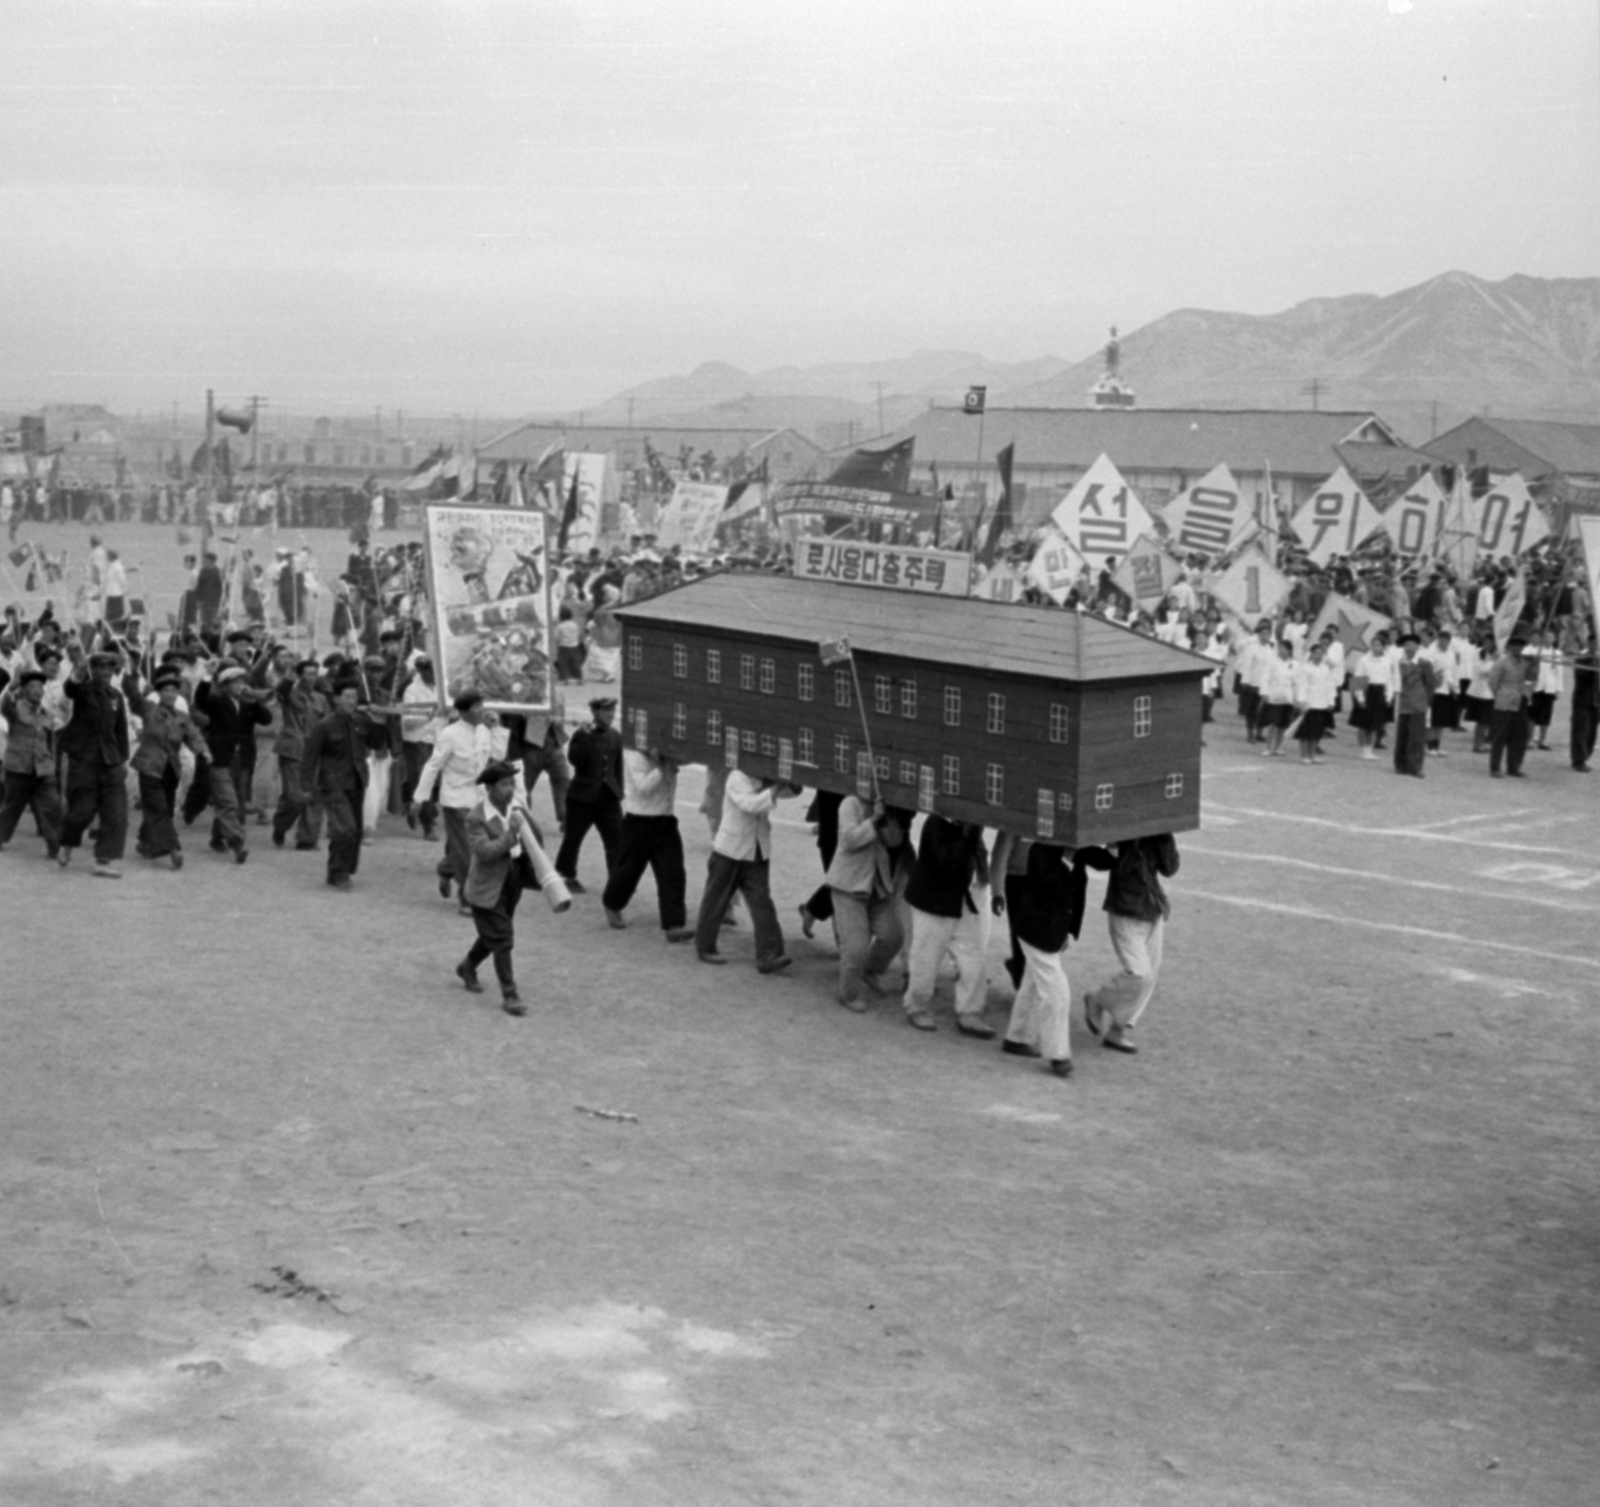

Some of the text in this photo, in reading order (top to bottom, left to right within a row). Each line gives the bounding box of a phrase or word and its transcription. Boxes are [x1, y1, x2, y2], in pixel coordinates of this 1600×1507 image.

[1079, 483, 1127, 553] 설
[1179, 486, 1239, 554] 을
[1312, 492, 1361, 551] 위
[1479, 494, 1532, 556] 여
[1244, 565, 1261, 614] 1
